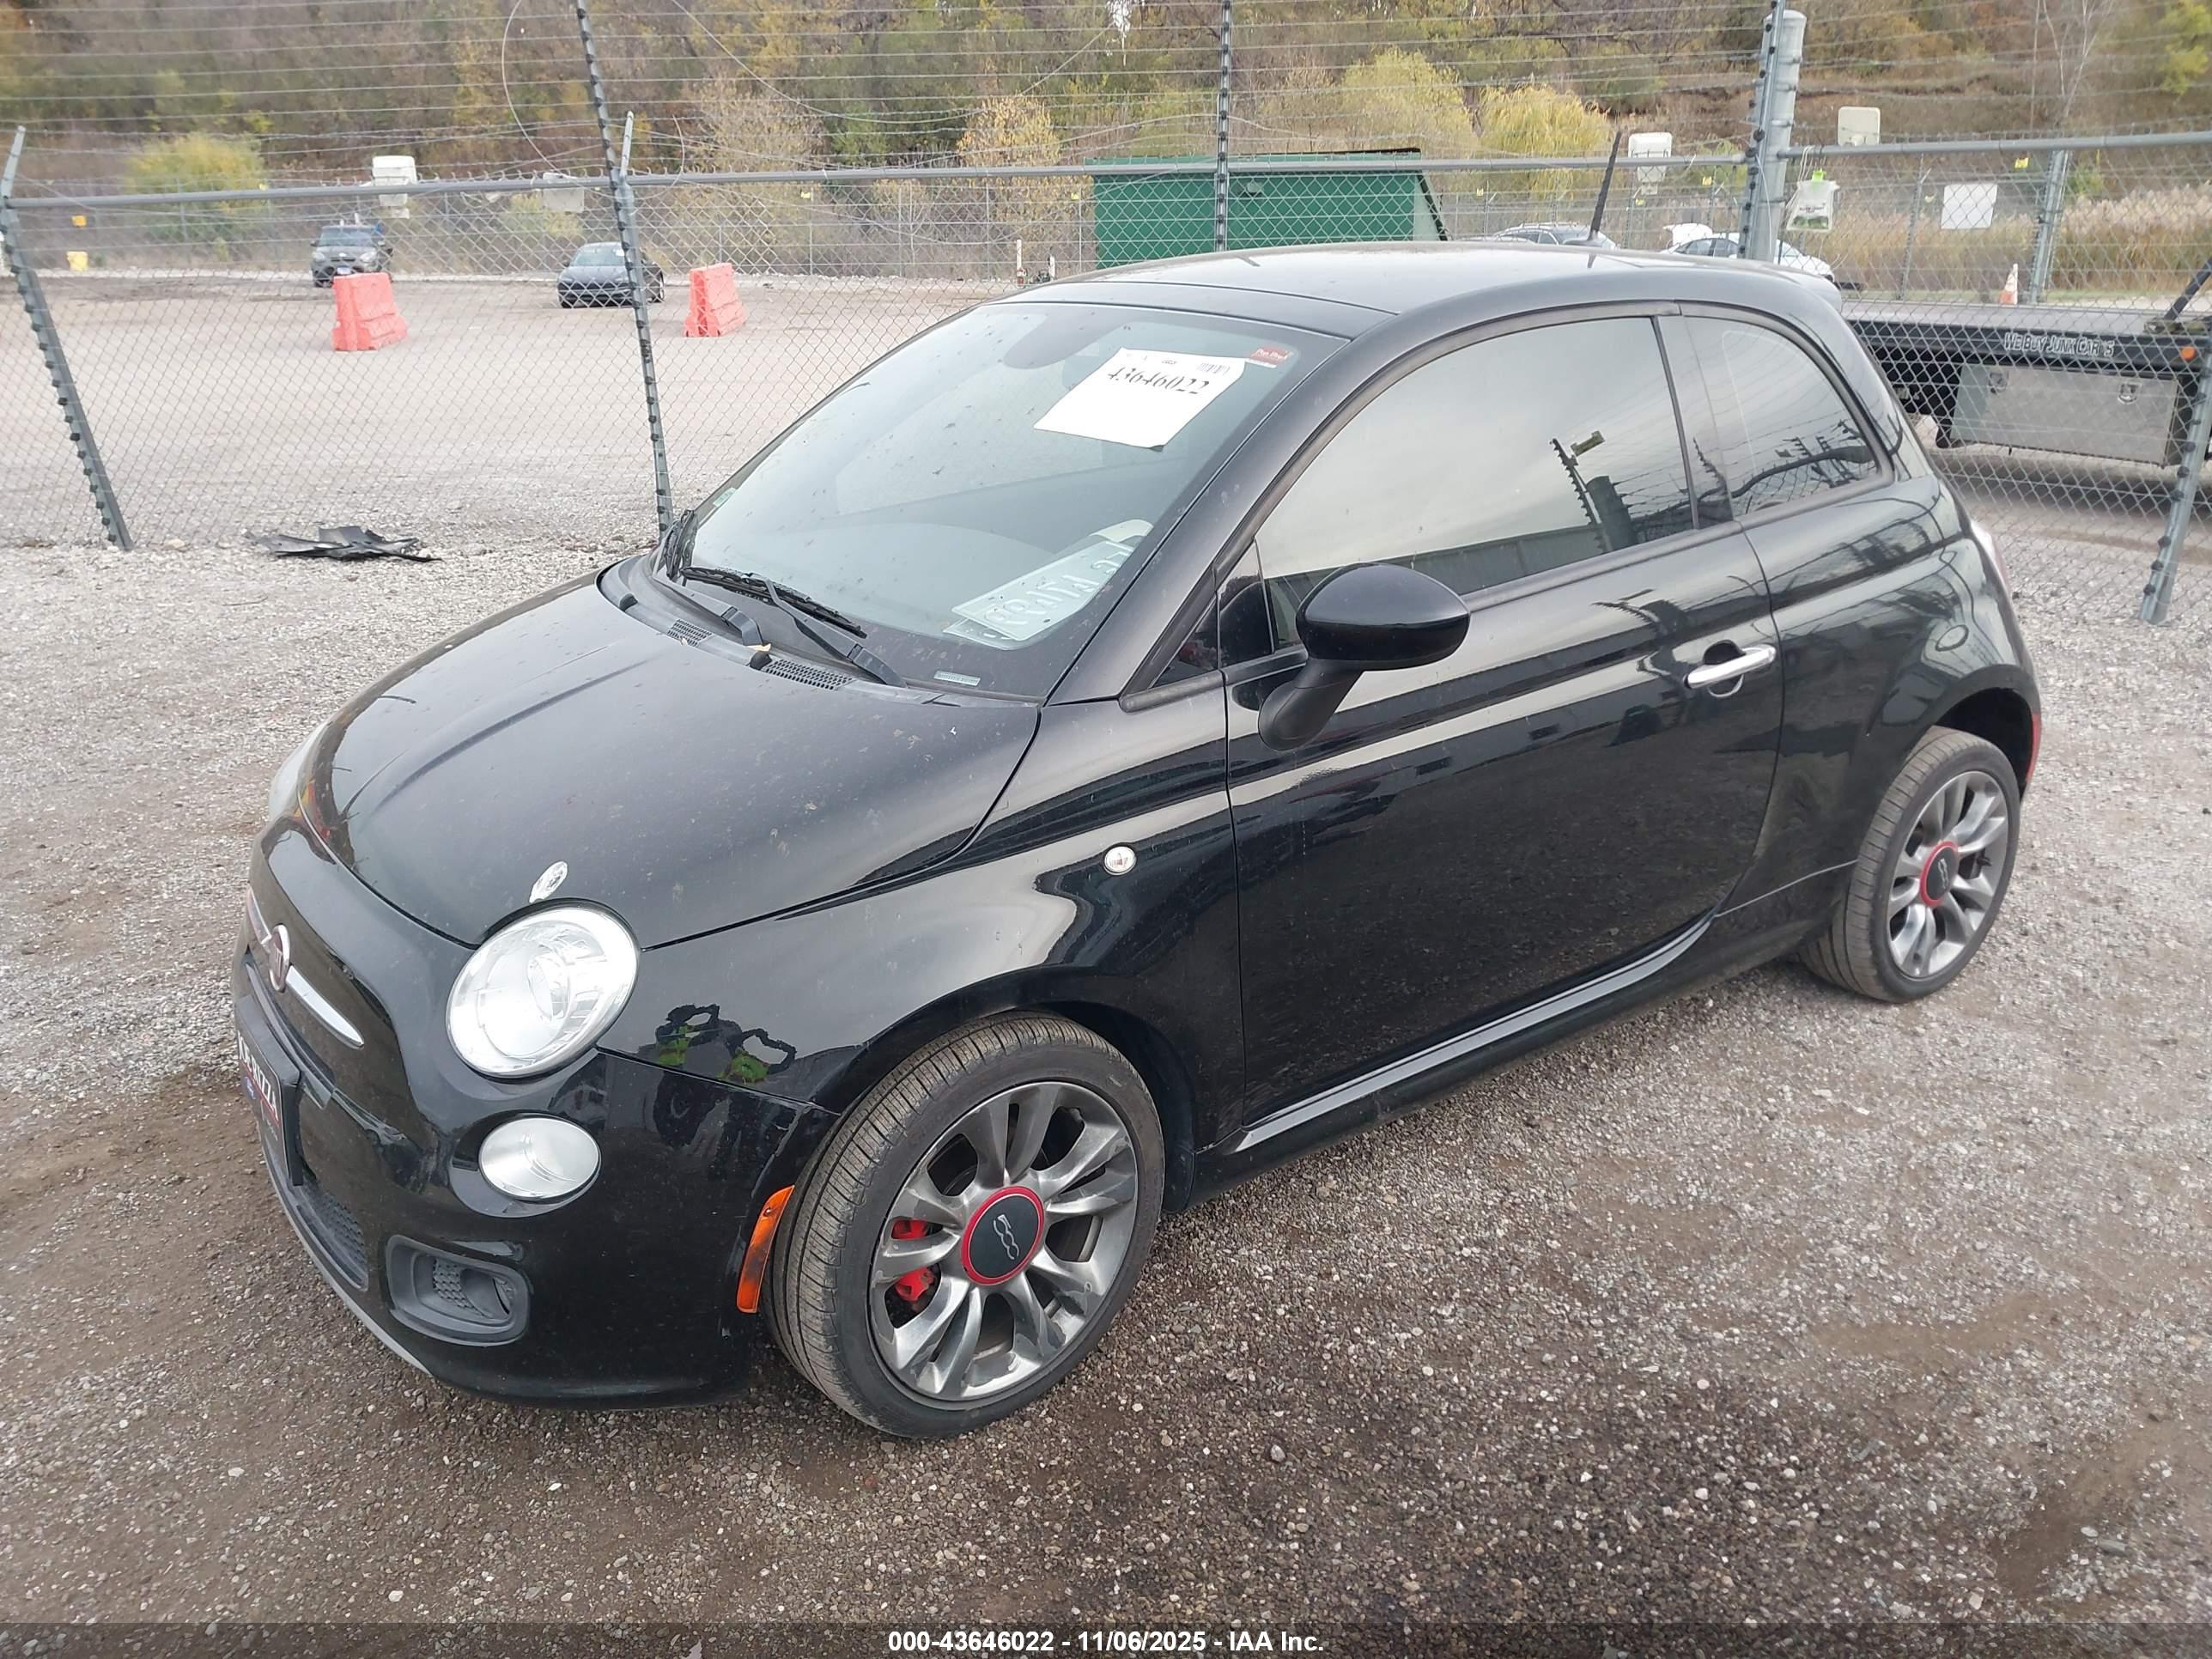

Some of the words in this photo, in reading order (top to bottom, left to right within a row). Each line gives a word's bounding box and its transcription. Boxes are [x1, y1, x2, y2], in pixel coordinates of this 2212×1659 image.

[2023, 333, 2047, 352] BUY
[2046, 335, 2075, 355] JUNK
[1107, 367, 1210, 395] 43646022
[251, 1054, 279, 1121] RIZZA
